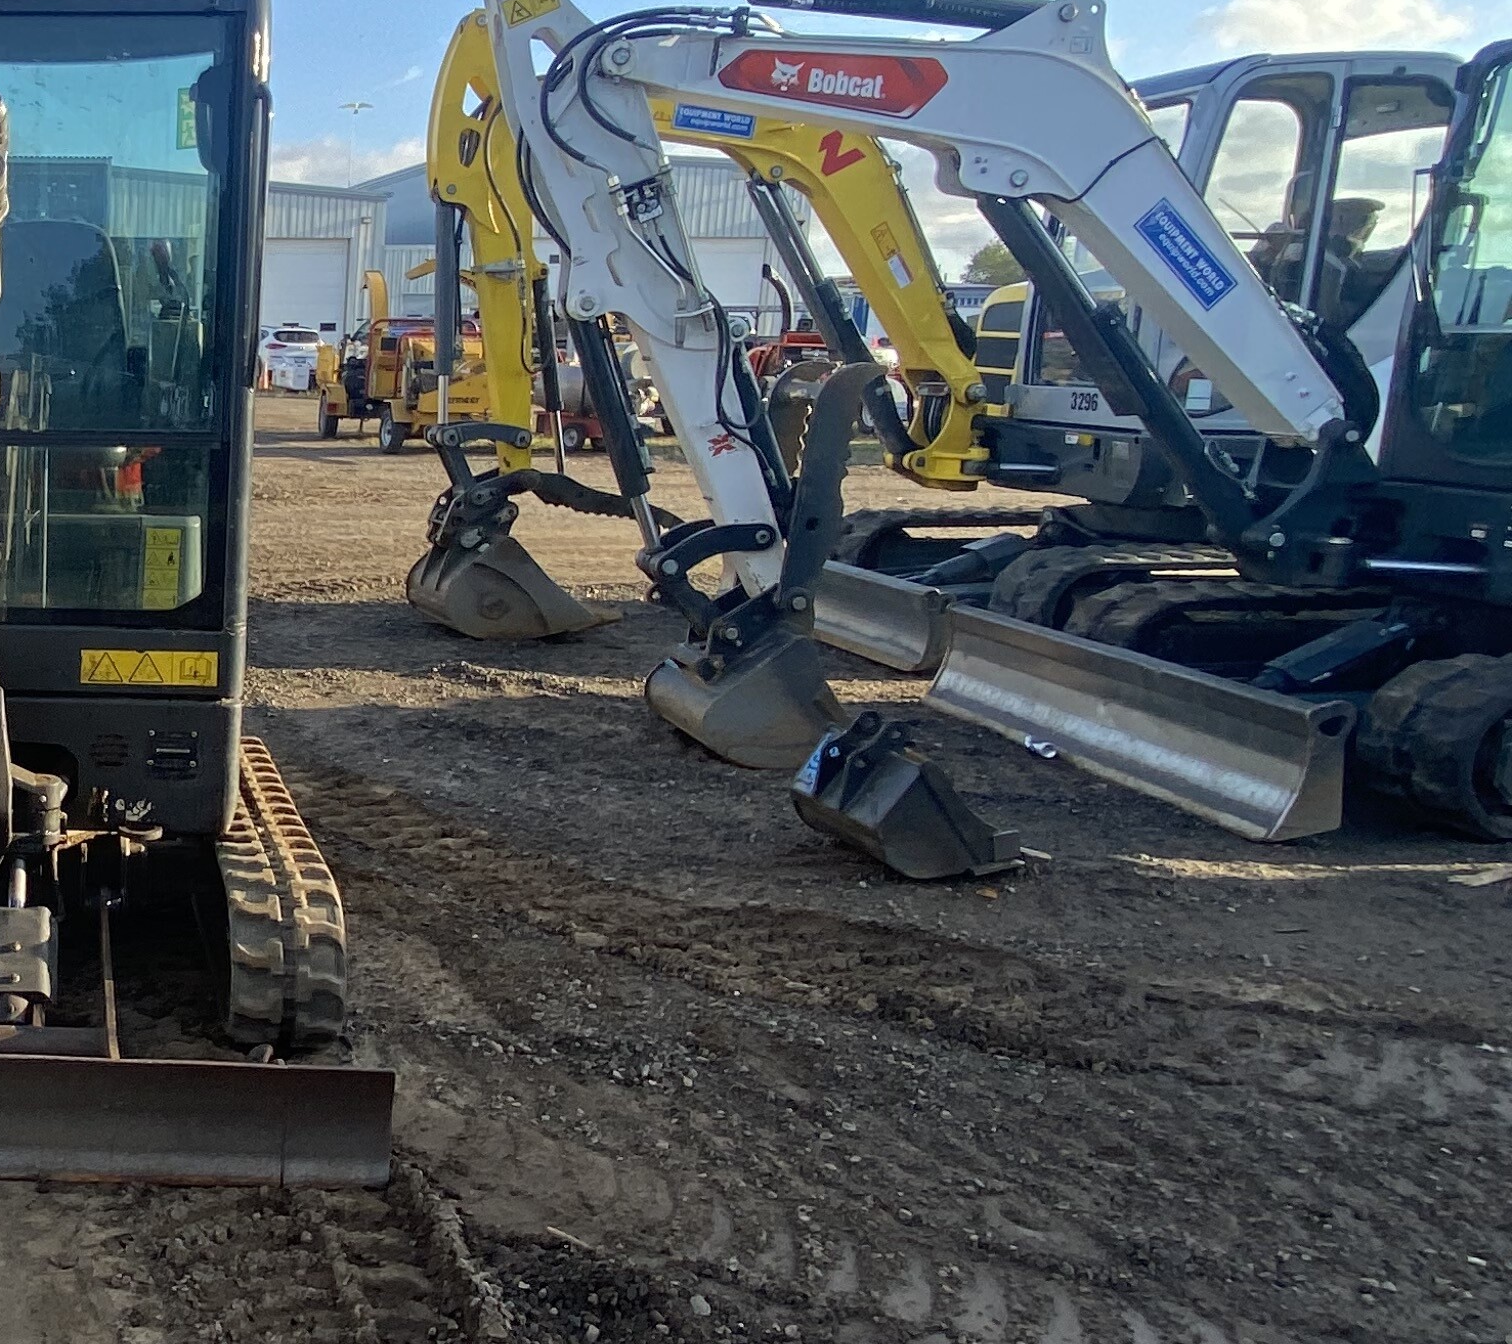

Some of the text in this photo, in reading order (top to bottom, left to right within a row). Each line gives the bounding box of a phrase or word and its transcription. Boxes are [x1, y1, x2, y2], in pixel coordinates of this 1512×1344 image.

[807, 67, 884, 99] Bobcat
[679, 107, 751, 124] EQUIPMENT WORLD
[1155, 211, 1225, 291] EQUIPMENT WORLD
[1158, 233, 1215, 297] equipworld.com
[1070, 391, 1099, 412] 3296
